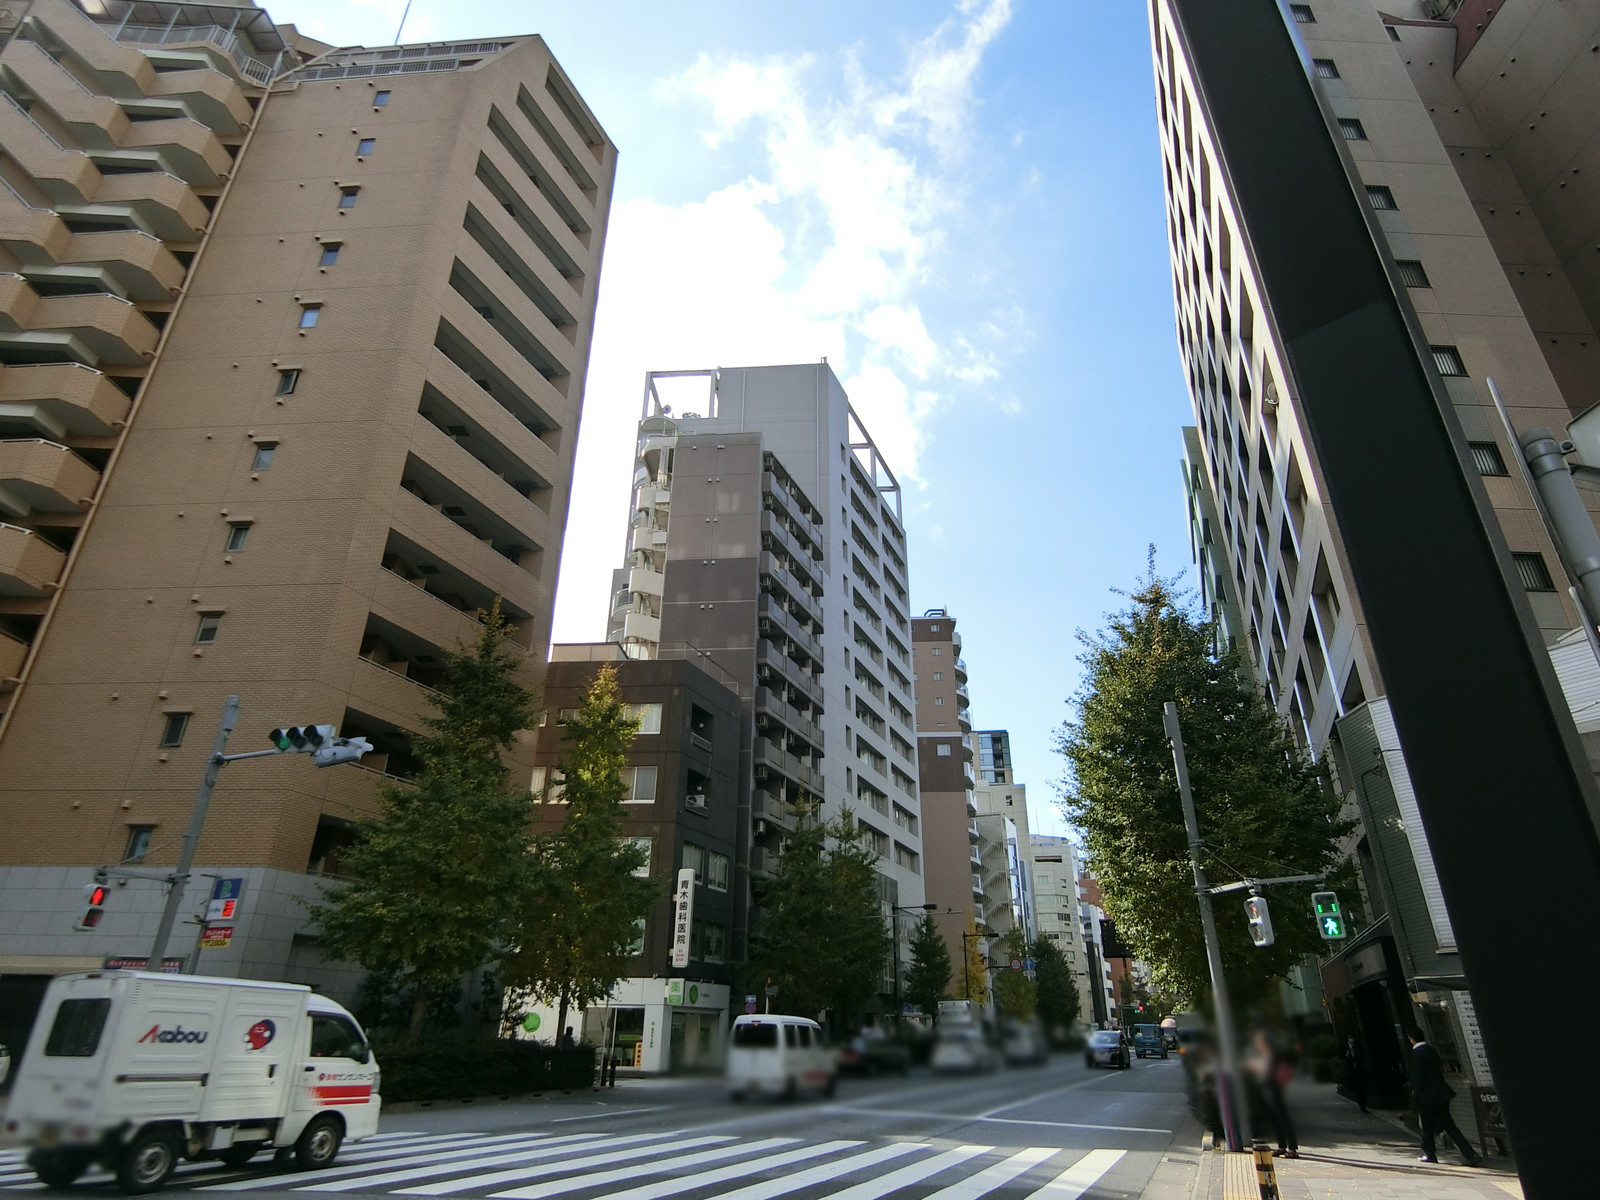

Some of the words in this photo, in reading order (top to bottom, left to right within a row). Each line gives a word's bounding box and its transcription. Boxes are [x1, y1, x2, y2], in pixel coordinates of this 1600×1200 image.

[677, 880, 689, 944] 青木歯科医院
